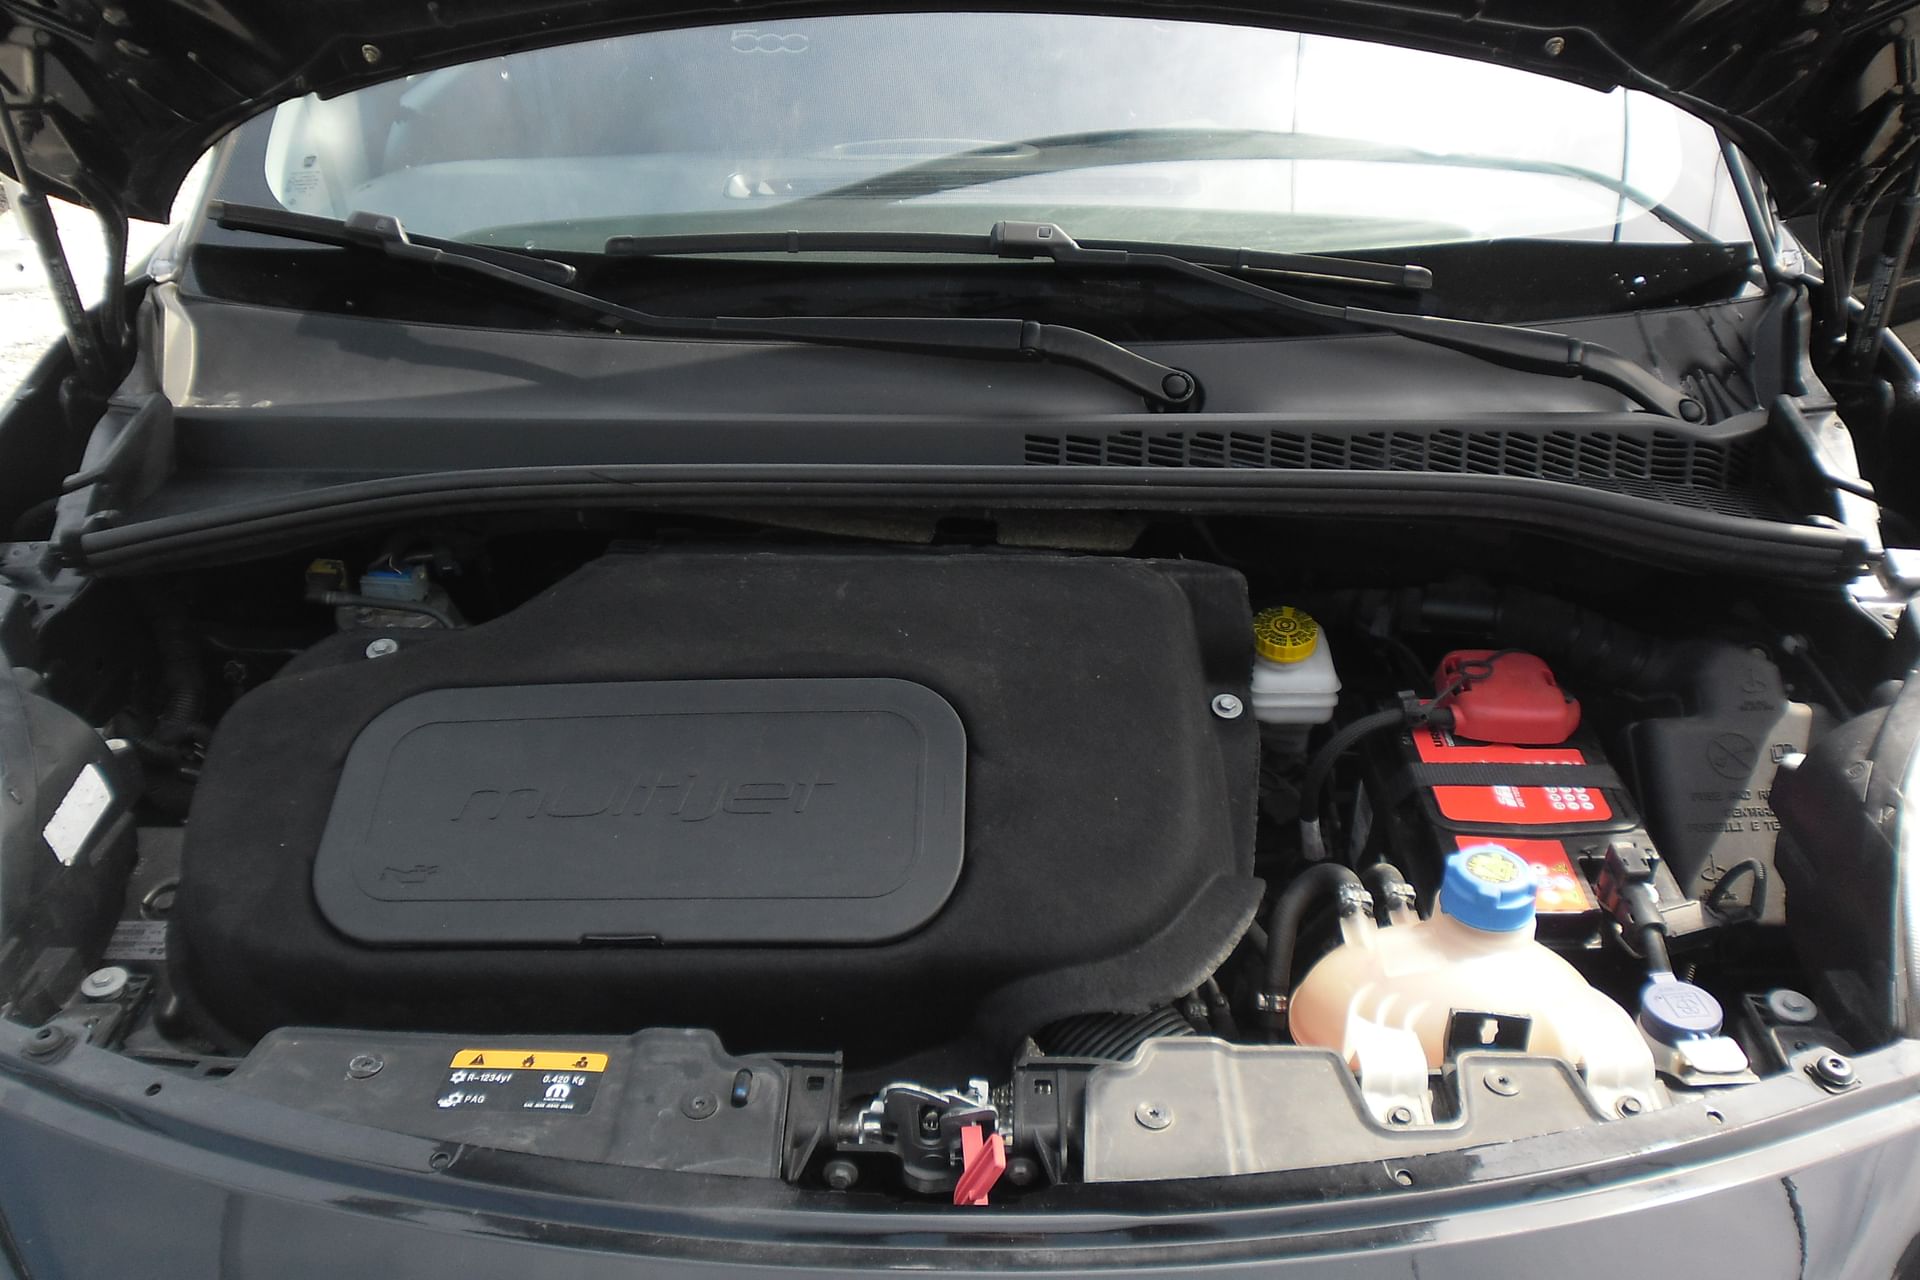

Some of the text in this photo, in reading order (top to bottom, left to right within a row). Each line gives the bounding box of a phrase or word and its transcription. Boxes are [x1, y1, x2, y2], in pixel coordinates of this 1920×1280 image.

[731, 29, 809, 53] 500
[450, 768, 836, 823] multijet
[466, 1072, 586, 1086] R-1234yf 0.420 Kg
